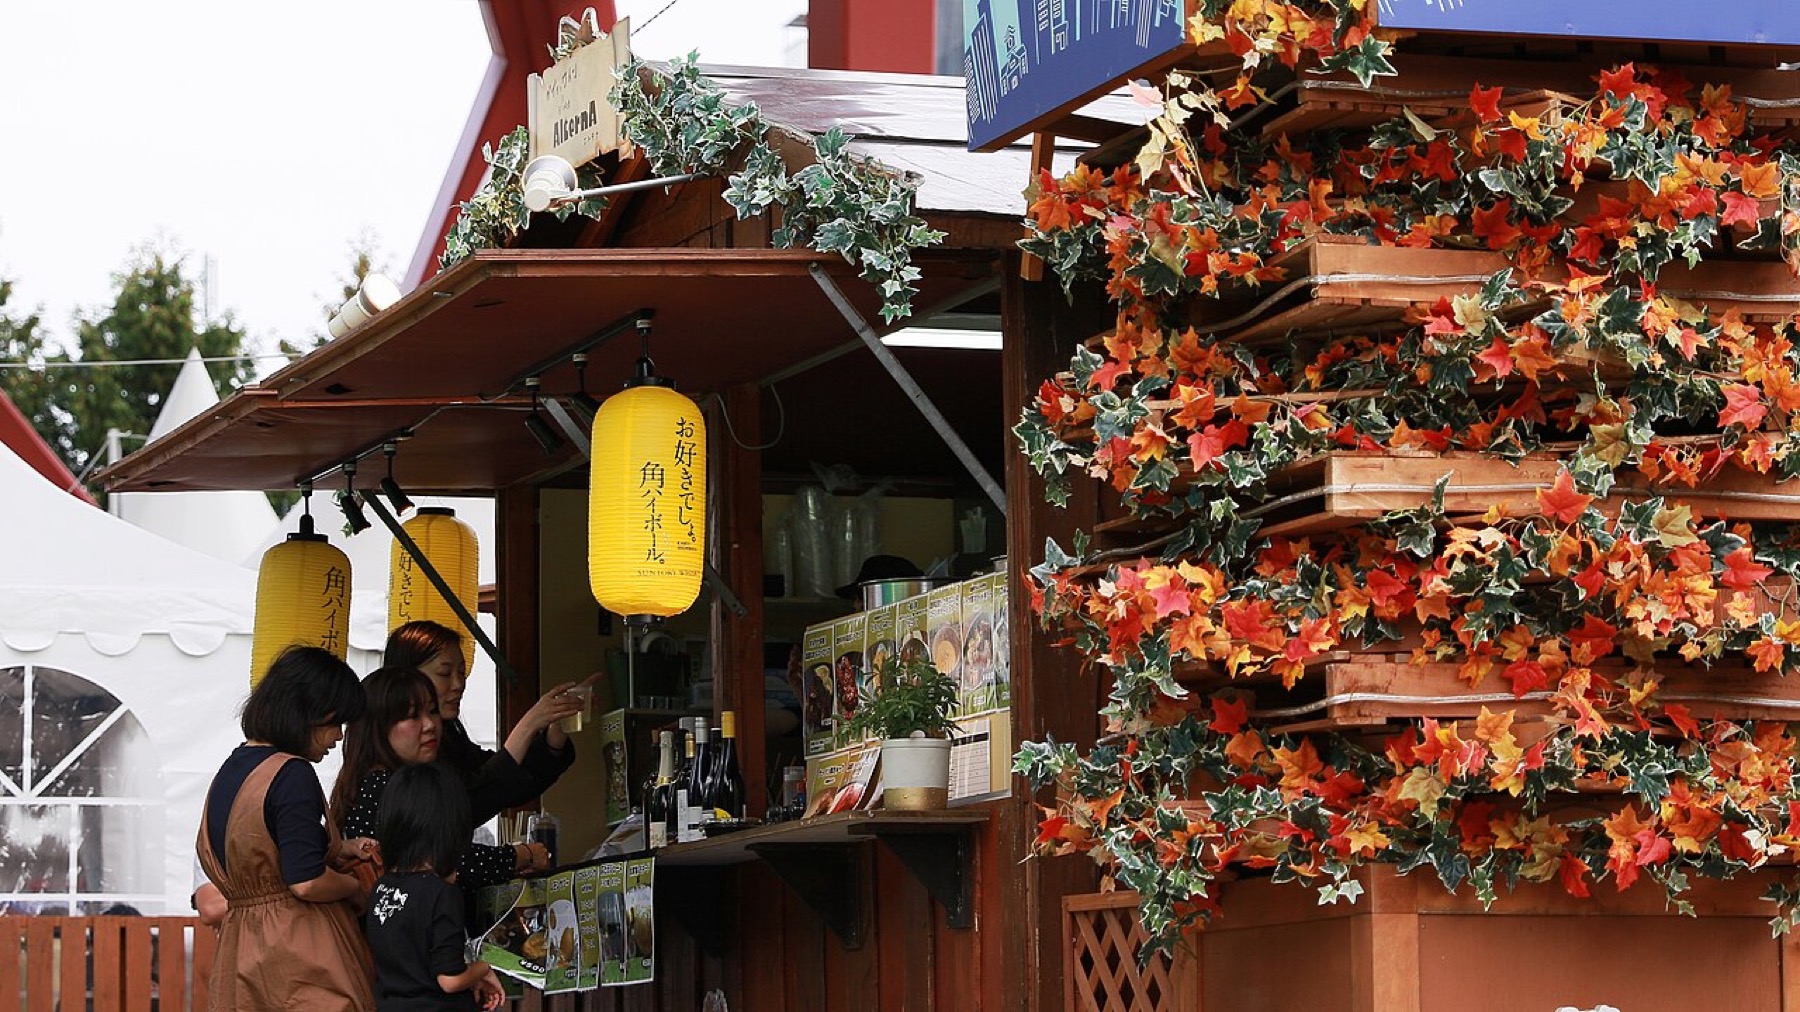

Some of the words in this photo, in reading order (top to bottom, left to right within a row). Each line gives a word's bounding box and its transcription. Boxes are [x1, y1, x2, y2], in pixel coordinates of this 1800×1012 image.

[639, 461, 666, 565] 角ハイボール。
[674, 416, 697, 543] お好きでしょ。
